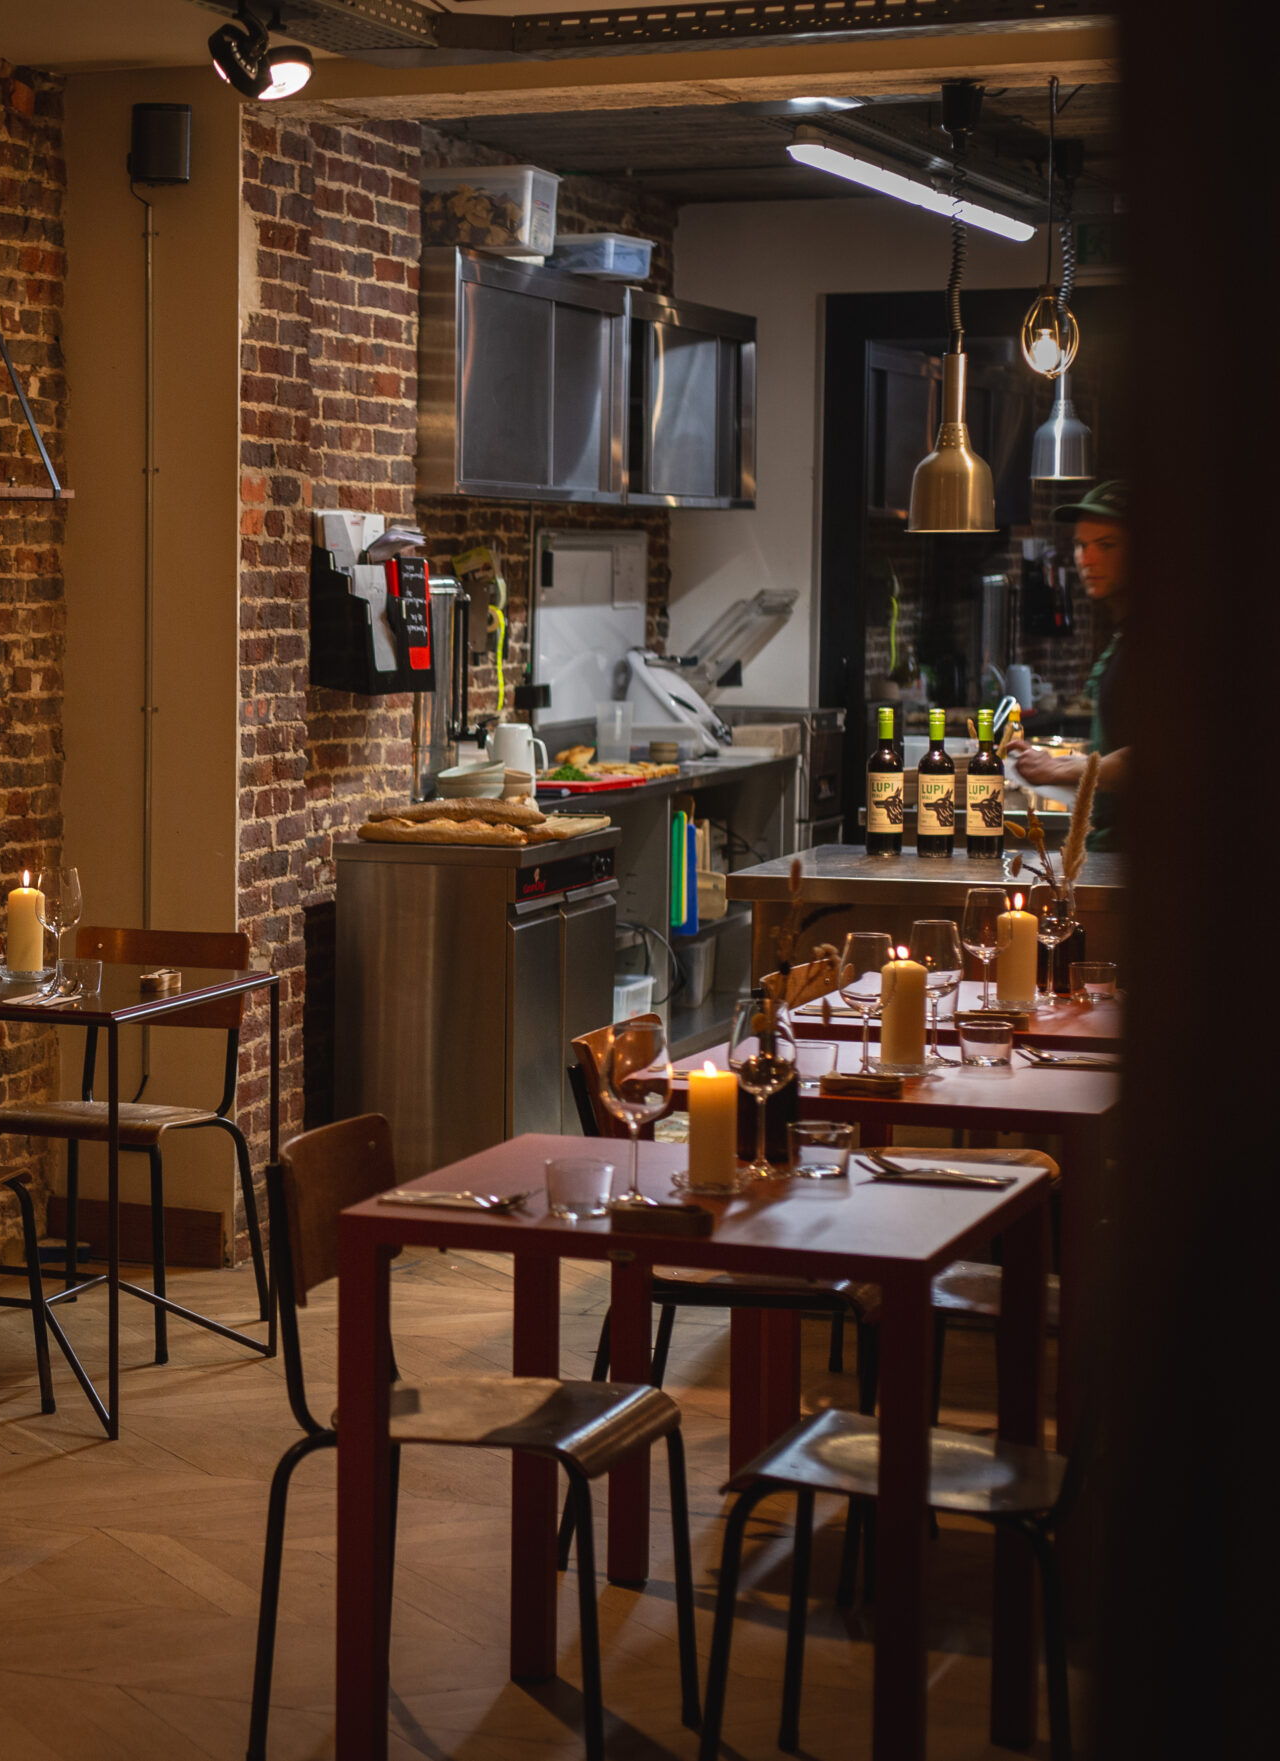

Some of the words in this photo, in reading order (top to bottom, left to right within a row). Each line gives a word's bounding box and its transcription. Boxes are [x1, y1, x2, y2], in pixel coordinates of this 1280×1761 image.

[871, 782, 894, 793] LUPI
[921, 784, 944, 794] LUPI
[968, 785, 990, 795] LUPI
